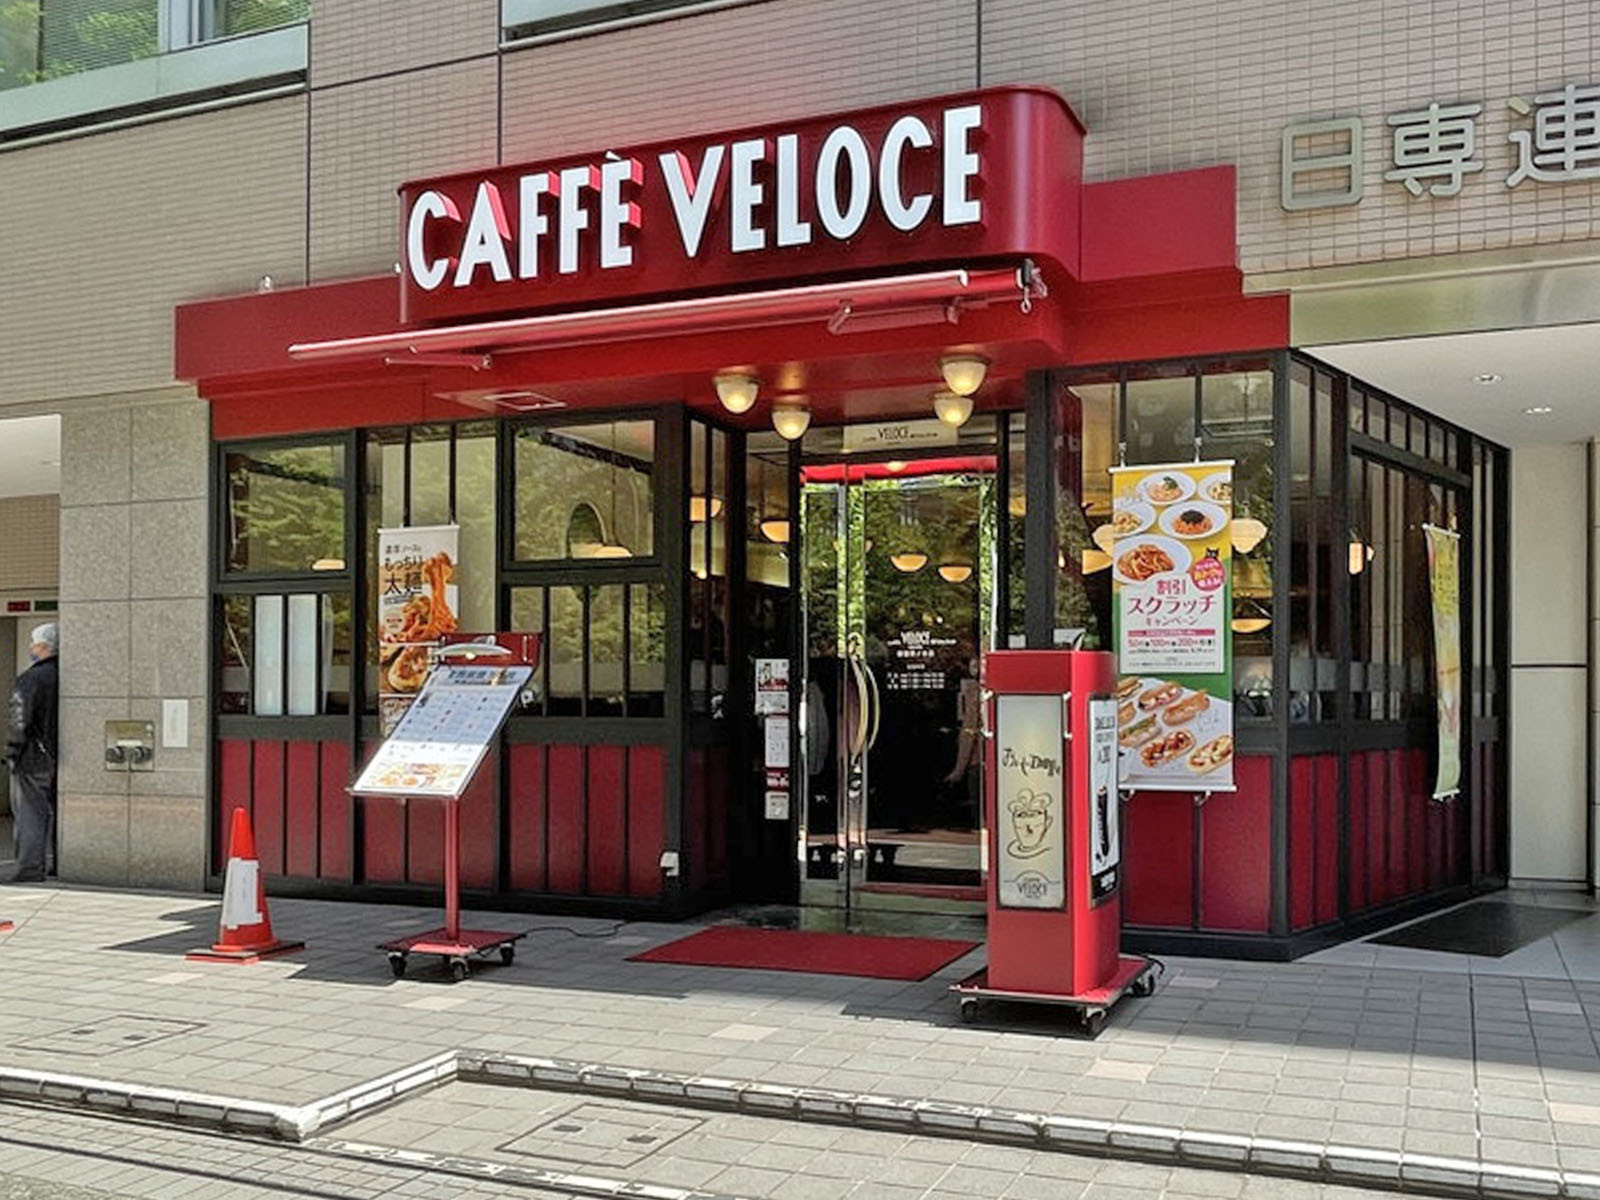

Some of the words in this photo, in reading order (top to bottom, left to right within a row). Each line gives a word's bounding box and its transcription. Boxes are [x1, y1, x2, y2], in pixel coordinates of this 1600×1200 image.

[408, 150, 640, 291] CAFFÈ
[659, 105, 982, 258] VELOCE
[1157, 579, 1187, 595] 割引
[1127, 595, 1216, 615] スクラッチ
[1146, 616, 1199, 627] キャンペーン
